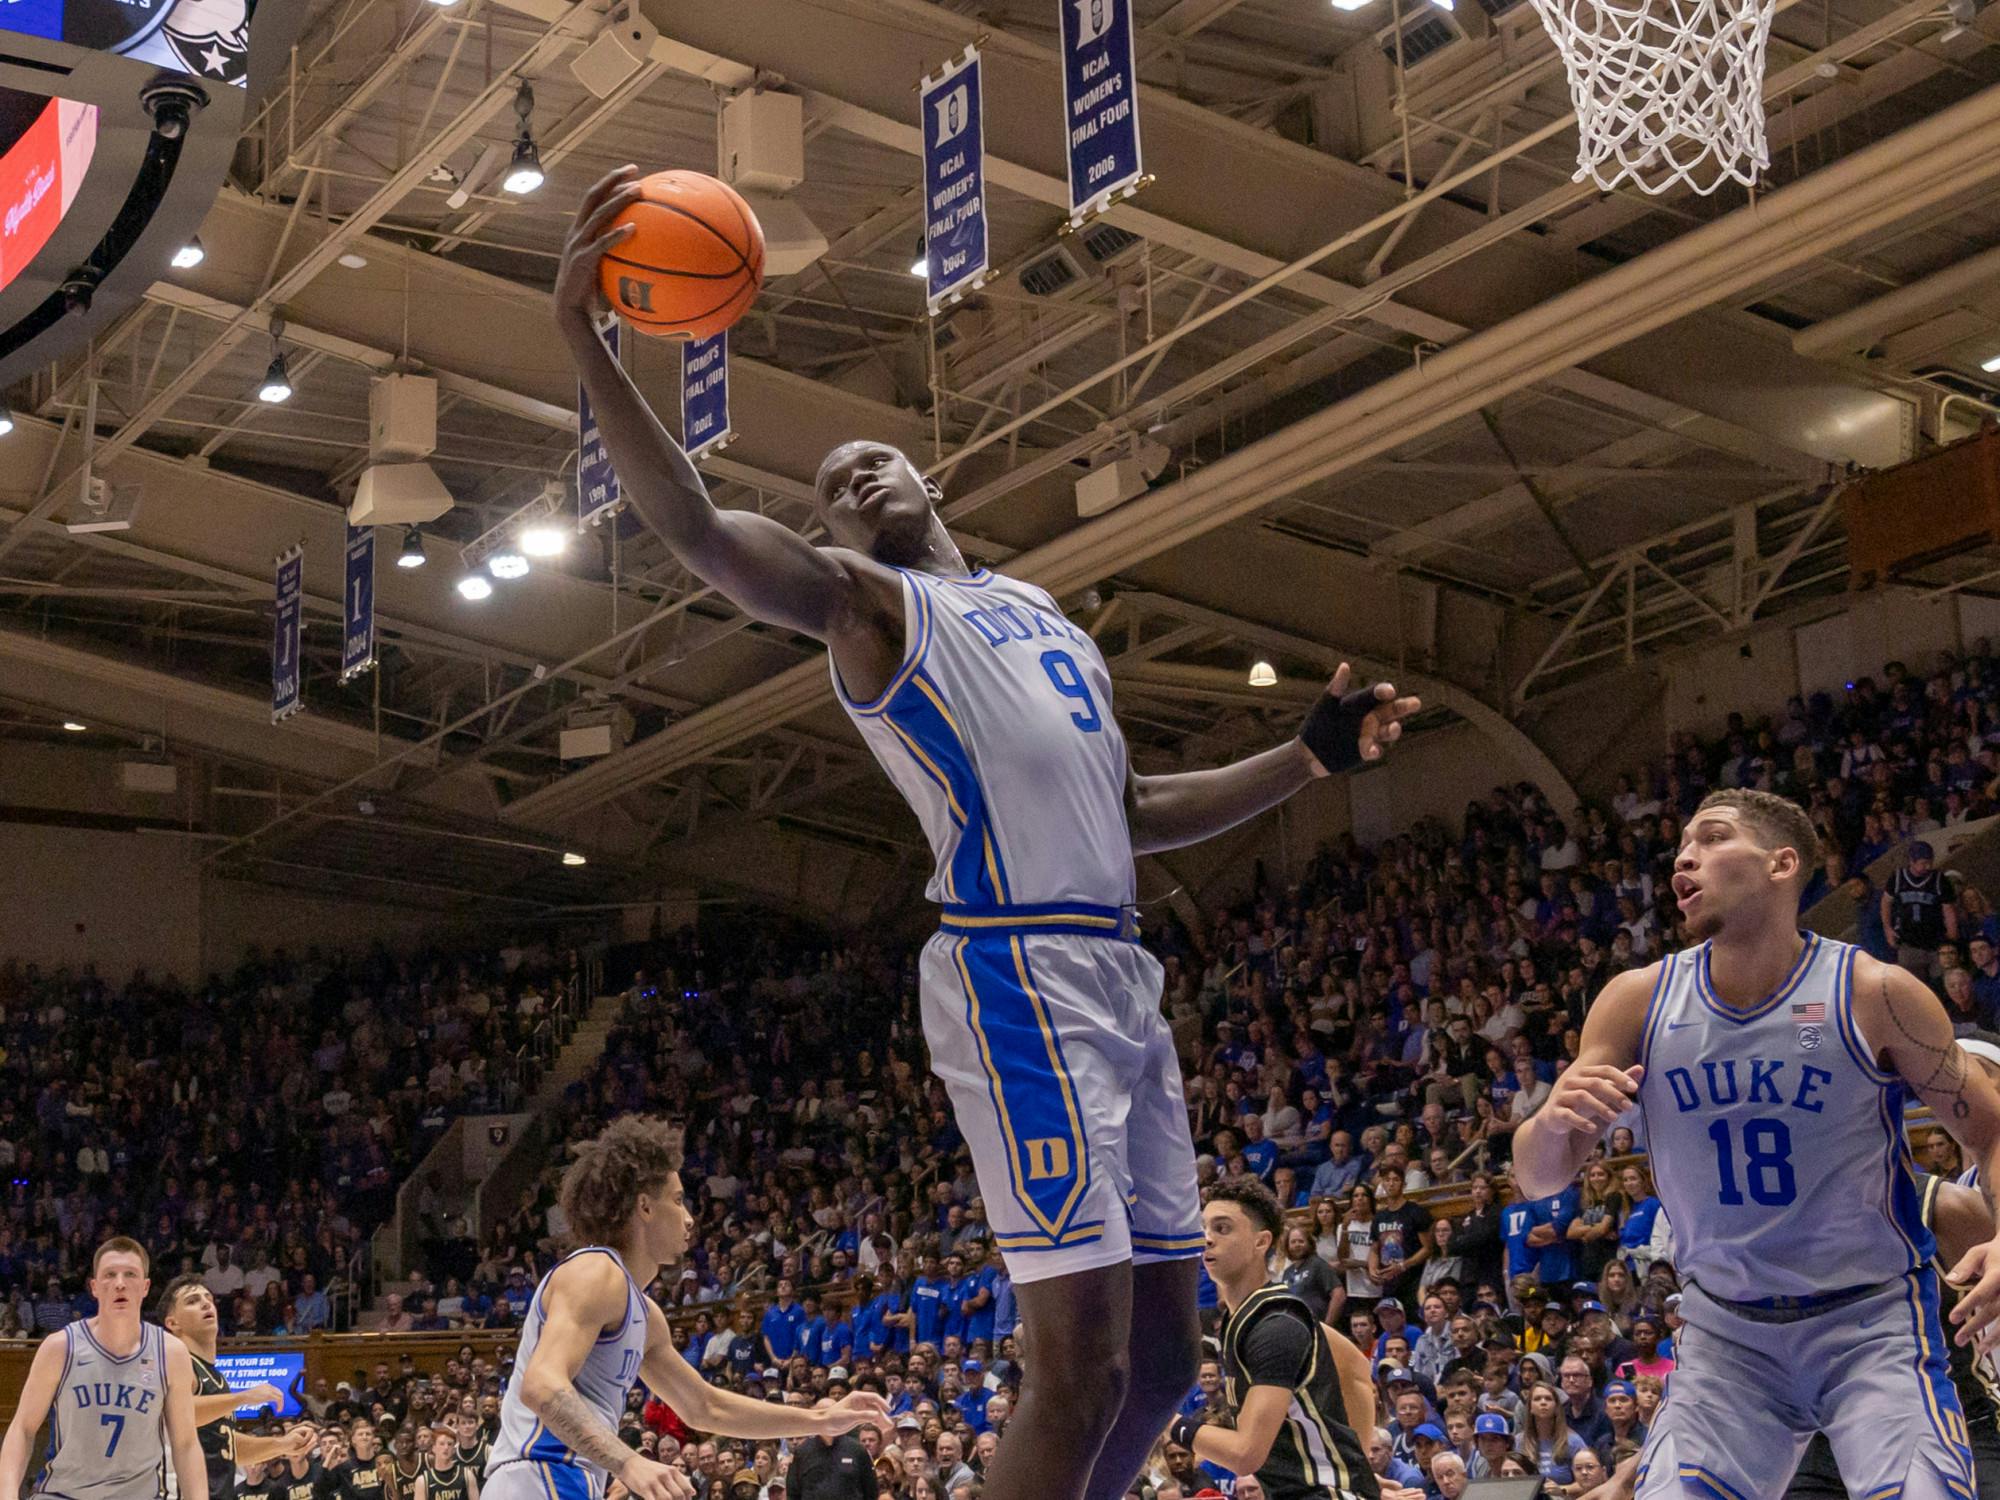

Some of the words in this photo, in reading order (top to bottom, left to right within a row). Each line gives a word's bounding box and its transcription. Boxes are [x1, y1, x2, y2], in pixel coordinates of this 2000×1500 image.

[1082, 51, 1110, 82] NCAA
[1073, 73, 1123, 116] WOMEN'S
[1072, 117, 1099, 149] FINAL
[1100, 98, 1130, 129] FOUR
[940, 152, 966, 178] NCAA
[1088, 155, 1116, 184] 2006
[933, 172, 975, 211] WOMEN'S
[929, 215, 955, 241] FINAL
[956, 196, 980, 231] FOUR
[942, 250, 967, 276] 2003
[1039, 649, 1102, 733] 9
[1665, 1060, 1832, 1113] DUKE
[1024, 1137, 1070, 1180] D
[1708, 1118, 1797, 1206] 18
[234, 1357, 258, 1367] YOUR
[237, 1368, 267, 1378] STRIPE
[72, 1383, 156, 1415] DUKE
[100, 1414, 125, 1458] 7
